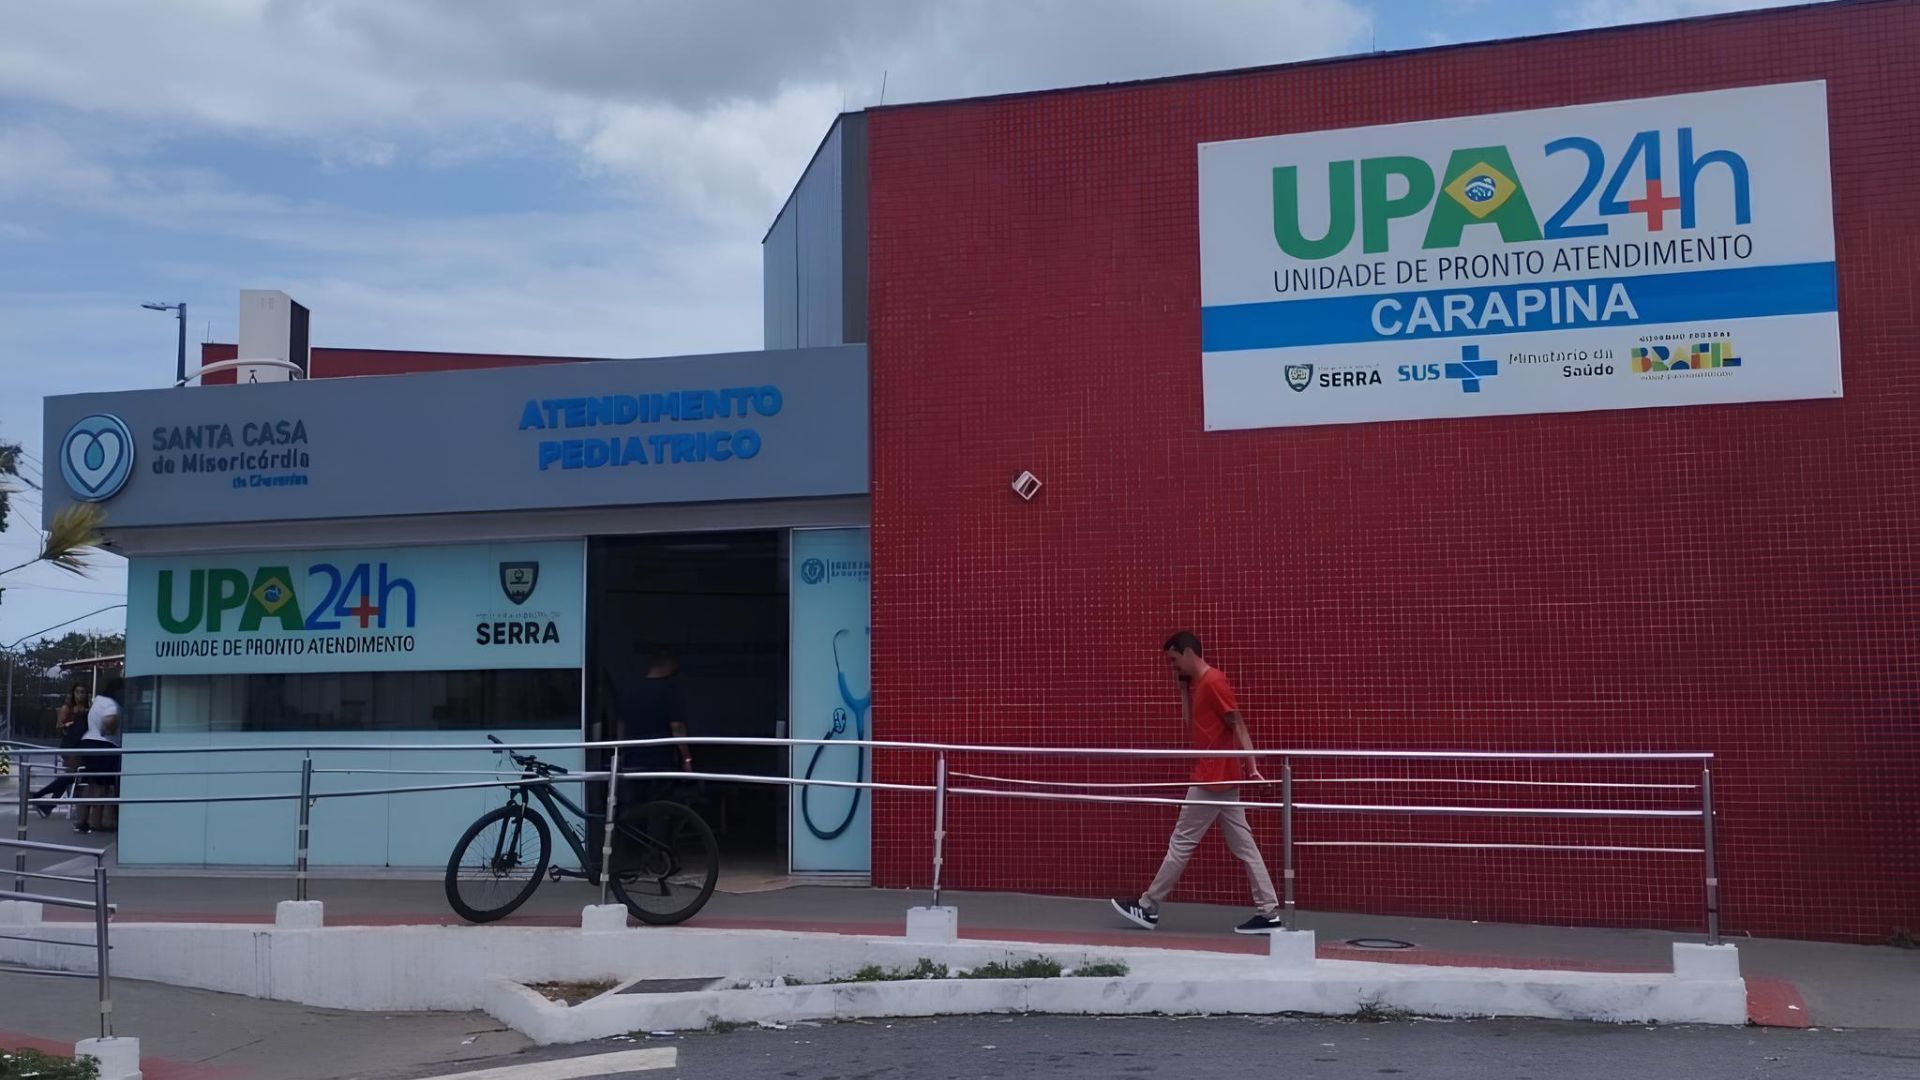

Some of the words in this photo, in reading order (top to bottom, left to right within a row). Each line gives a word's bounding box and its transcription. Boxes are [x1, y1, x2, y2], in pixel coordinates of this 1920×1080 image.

[1272, 145, 1544, 260] UPA
[1543, 127, 1752, 241] 24h
[1274, 261, 1386, 293] UNIDADE
[1398, 259, 1429, 284] DE
[1439, 250, 1545, 281] PRONTO
[1553, 234, 1753, 272] ATENDIMENTO
[1371, 283, 1639, 336] CARAPINA
[1319, 370, 1382, 387] SERRA
[1397, 364, 1441, 381] SUS
[518, 384, 783, 430] ATENDIMENTO
[152, 423, 234, 451] SANTA
[242, 419, 308, 446] CASA
[538, 428, 761, 470] PEDIATRICO
[156, 566, 305, 634] UPA
[304, 562, 416, 630] 24h
[155, 640, 218, 657] UNIDADE
[223, 639, 242, 655] DE
[246, 638, 304, 655] PRONTO
[307, 635, 415, 654] ATENDIMENTO
[476, 621, 560, 645] SERRA
